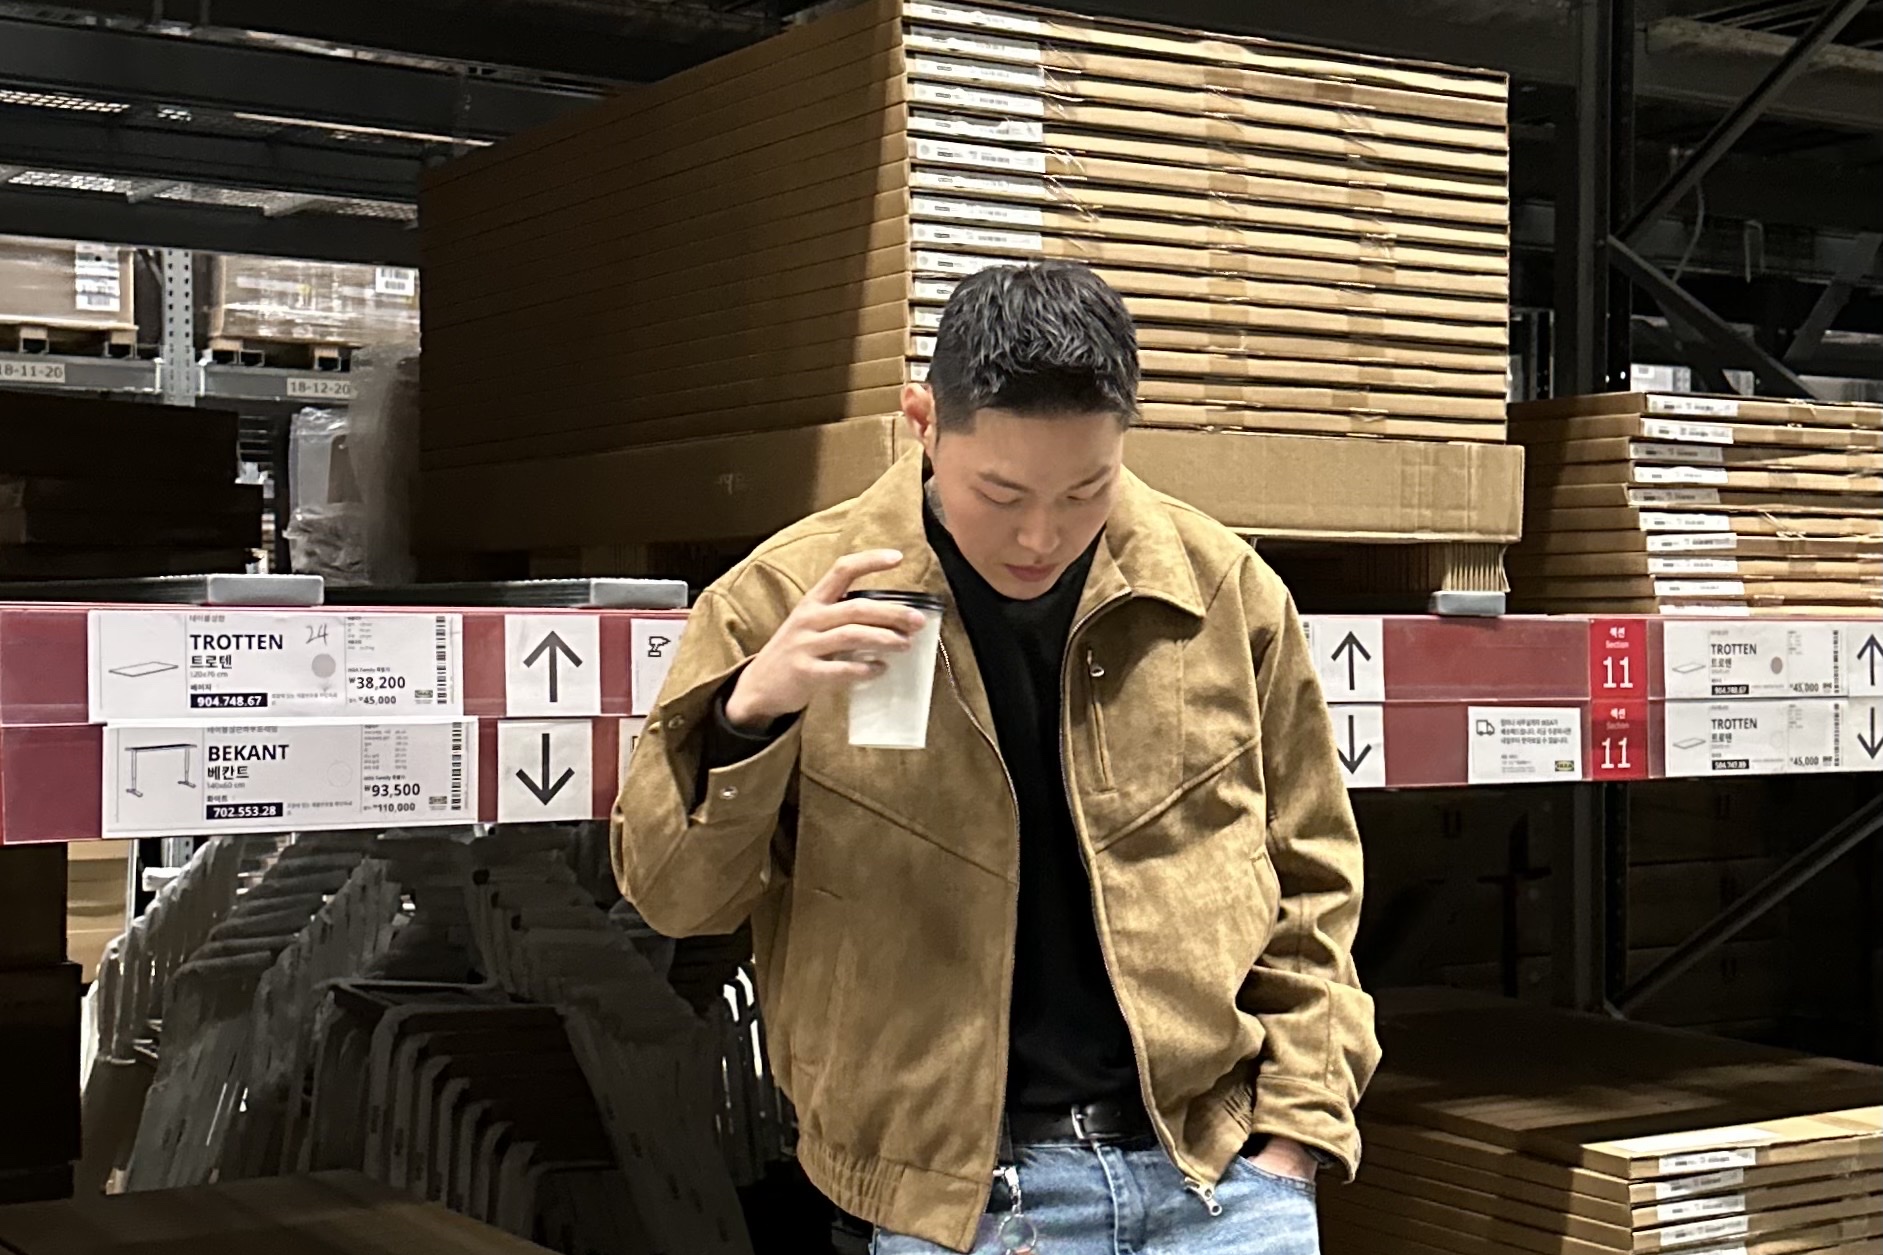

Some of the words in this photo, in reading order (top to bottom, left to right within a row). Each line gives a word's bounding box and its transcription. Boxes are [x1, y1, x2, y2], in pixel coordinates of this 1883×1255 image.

[190, 634, 283, 650] TROTTEN
[305, 623, 328, 646] 24
[1711, 643, 1757, 655] TROTTEN
[190, 654, 232, 669] 트로텐
[1602, 656, 1634, 688] 11
[197, 696, 262, 707] 904.748.67
[1711, 718, 1758, 730] TROTTEN
[208, 744, 290, 761] BEKANT
[1600, 737, 1631, 769] 11
[207, 766, 249, 780] 베칸트
[213, 806, 277, 818] 702.553.28
